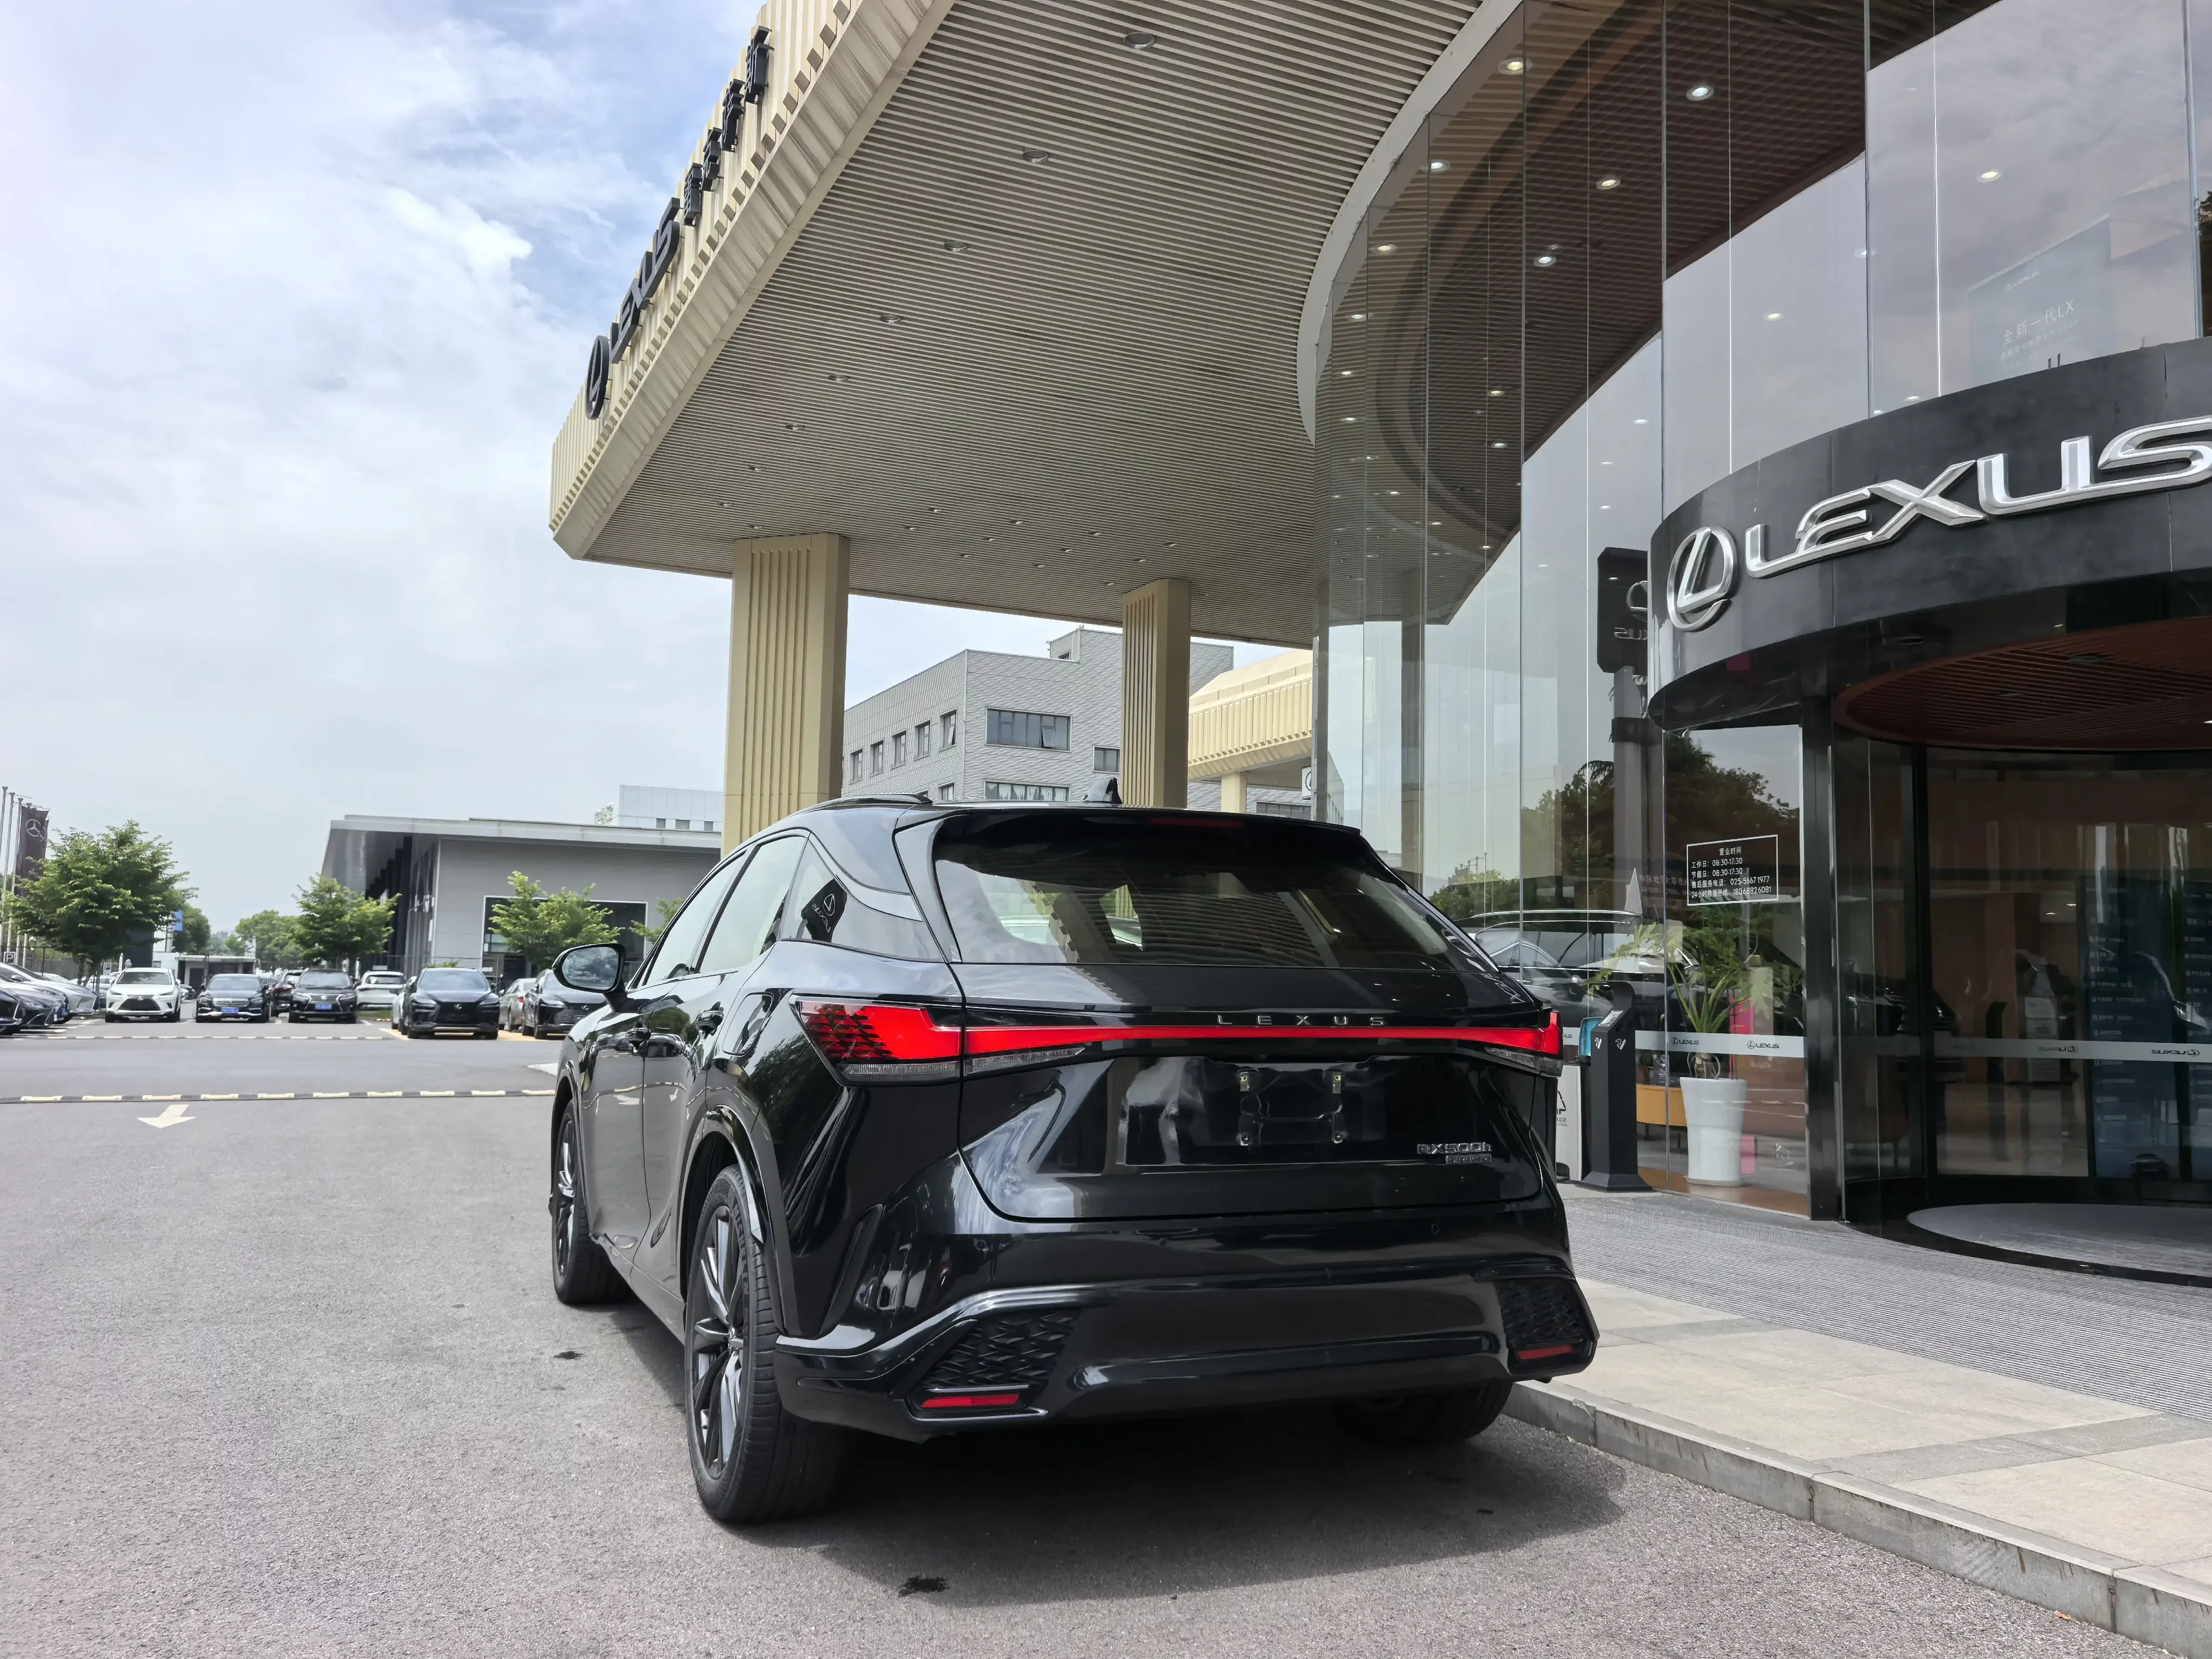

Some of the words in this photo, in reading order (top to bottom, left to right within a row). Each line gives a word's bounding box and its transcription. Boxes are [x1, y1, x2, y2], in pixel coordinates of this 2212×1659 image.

[610, 198, 680, 365] LEXUS
[1746, 415, 2212, 578] LEXUS
[1719, 846, 1742, 856] 营业时间
[6, 954, 14, 962] P
[1217, 1014, 1386, 1027] LEXUS
